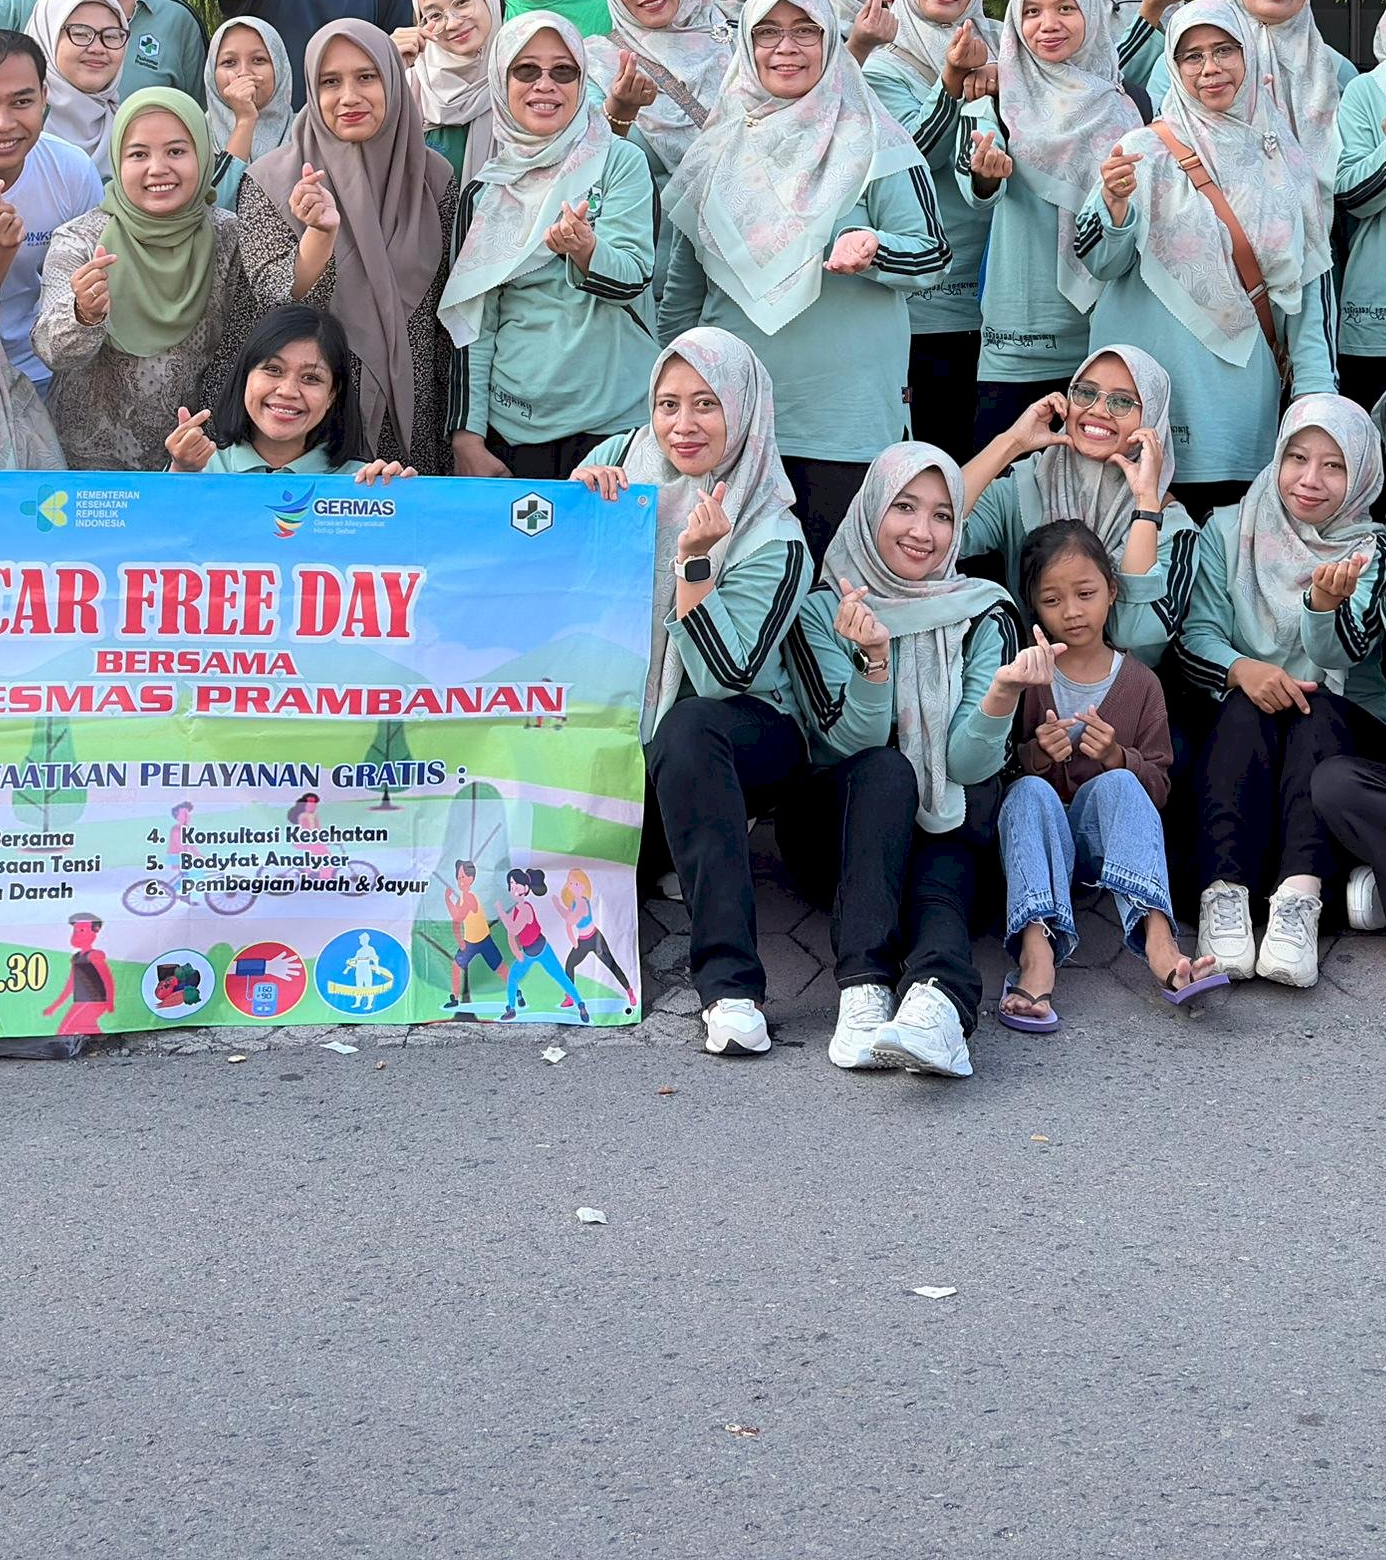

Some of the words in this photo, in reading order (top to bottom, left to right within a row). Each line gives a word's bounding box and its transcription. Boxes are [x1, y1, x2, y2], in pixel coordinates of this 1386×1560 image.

[76, 491, 140, 500] KEMENTERIAN
[76, 500, 128, 509] KESEHATAN
[75, 510, 119, 518] REPUBLIK
[313, 499, 394, 516] GERMAS
[75, 519, 126, 528] INDONESIA
[121, 568, 276, 637] FREE
[295, 571, 421, 638] DAY
[96, 650, 298, 676] BERSAMA
[196, 685, 564, 716] PRAMBANAN
[140, 763, 320, 787] PELAYANAN
[331, 761, 446, 788] GRATIS
[146, 828, 166, 844] 4.
[181, 826, 280, 845] Konsultasi
[286, 825, 389, 843] Kesehatan
[50, 854, 102, 873] Tensi
[146, 855, 164, 871] 5.
[180, 851, 259, 871] Bodyfat
[264, 851, 349, 870] Analyser
[9, 882, 74, 900] Darah
[145, 881, 164, 897] 6.
[299, 875, 351, 893] buah
[355, 876, 370, 893] &
[375, 876, 429, 897] Sayur
